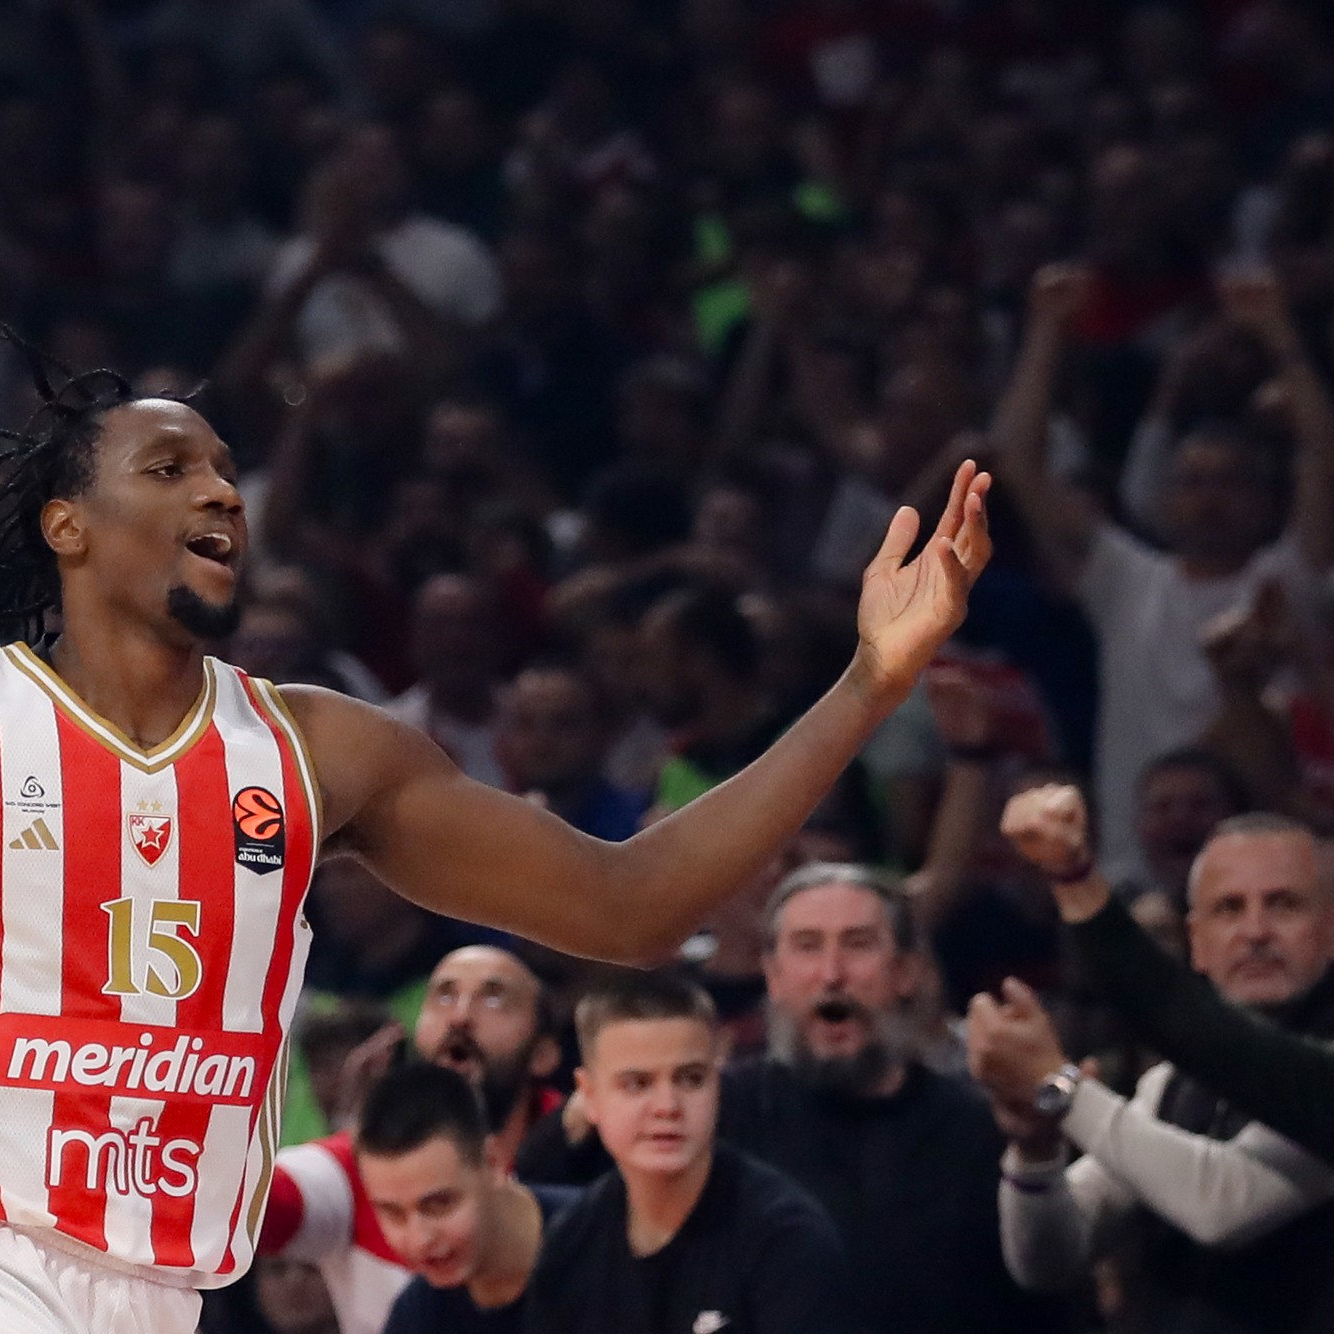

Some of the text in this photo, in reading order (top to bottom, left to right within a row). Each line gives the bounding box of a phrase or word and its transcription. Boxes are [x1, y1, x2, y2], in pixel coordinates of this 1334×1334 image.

[131, 817, 145, 826] KK
[238, 852, 282, 865] abu dhabi
[99, 896, 203, 1000] 15
[7, 1032, 255, 1097] meridian
[49, 1119, 201, 1197] mts
